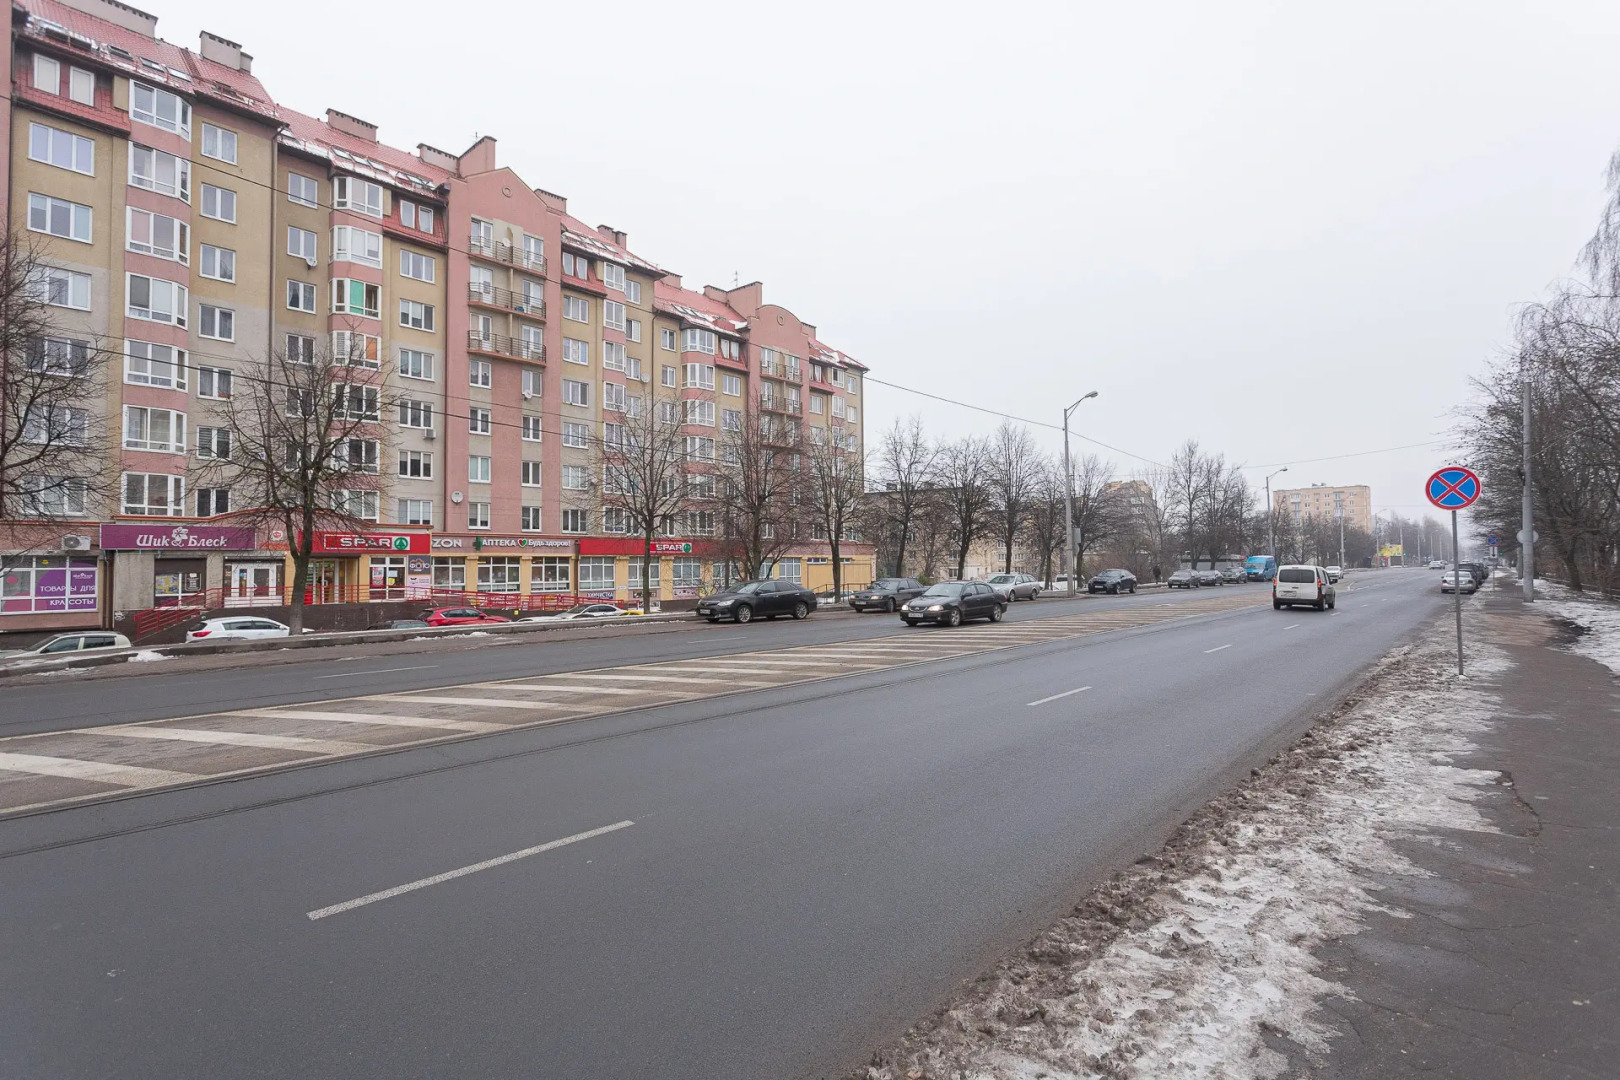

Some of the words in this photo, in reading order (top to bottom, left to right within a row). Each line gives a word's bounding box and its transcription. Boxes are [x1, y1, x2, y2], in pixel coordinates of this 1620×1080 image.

[136, 534, 170, 546] Шик
[187, 535, 228, 547] Блеск
[340, 537, 391, 548] SPAR
[482, 539, 516, 547] АПТЕКА
[528, 539, 544, 547] Будь
